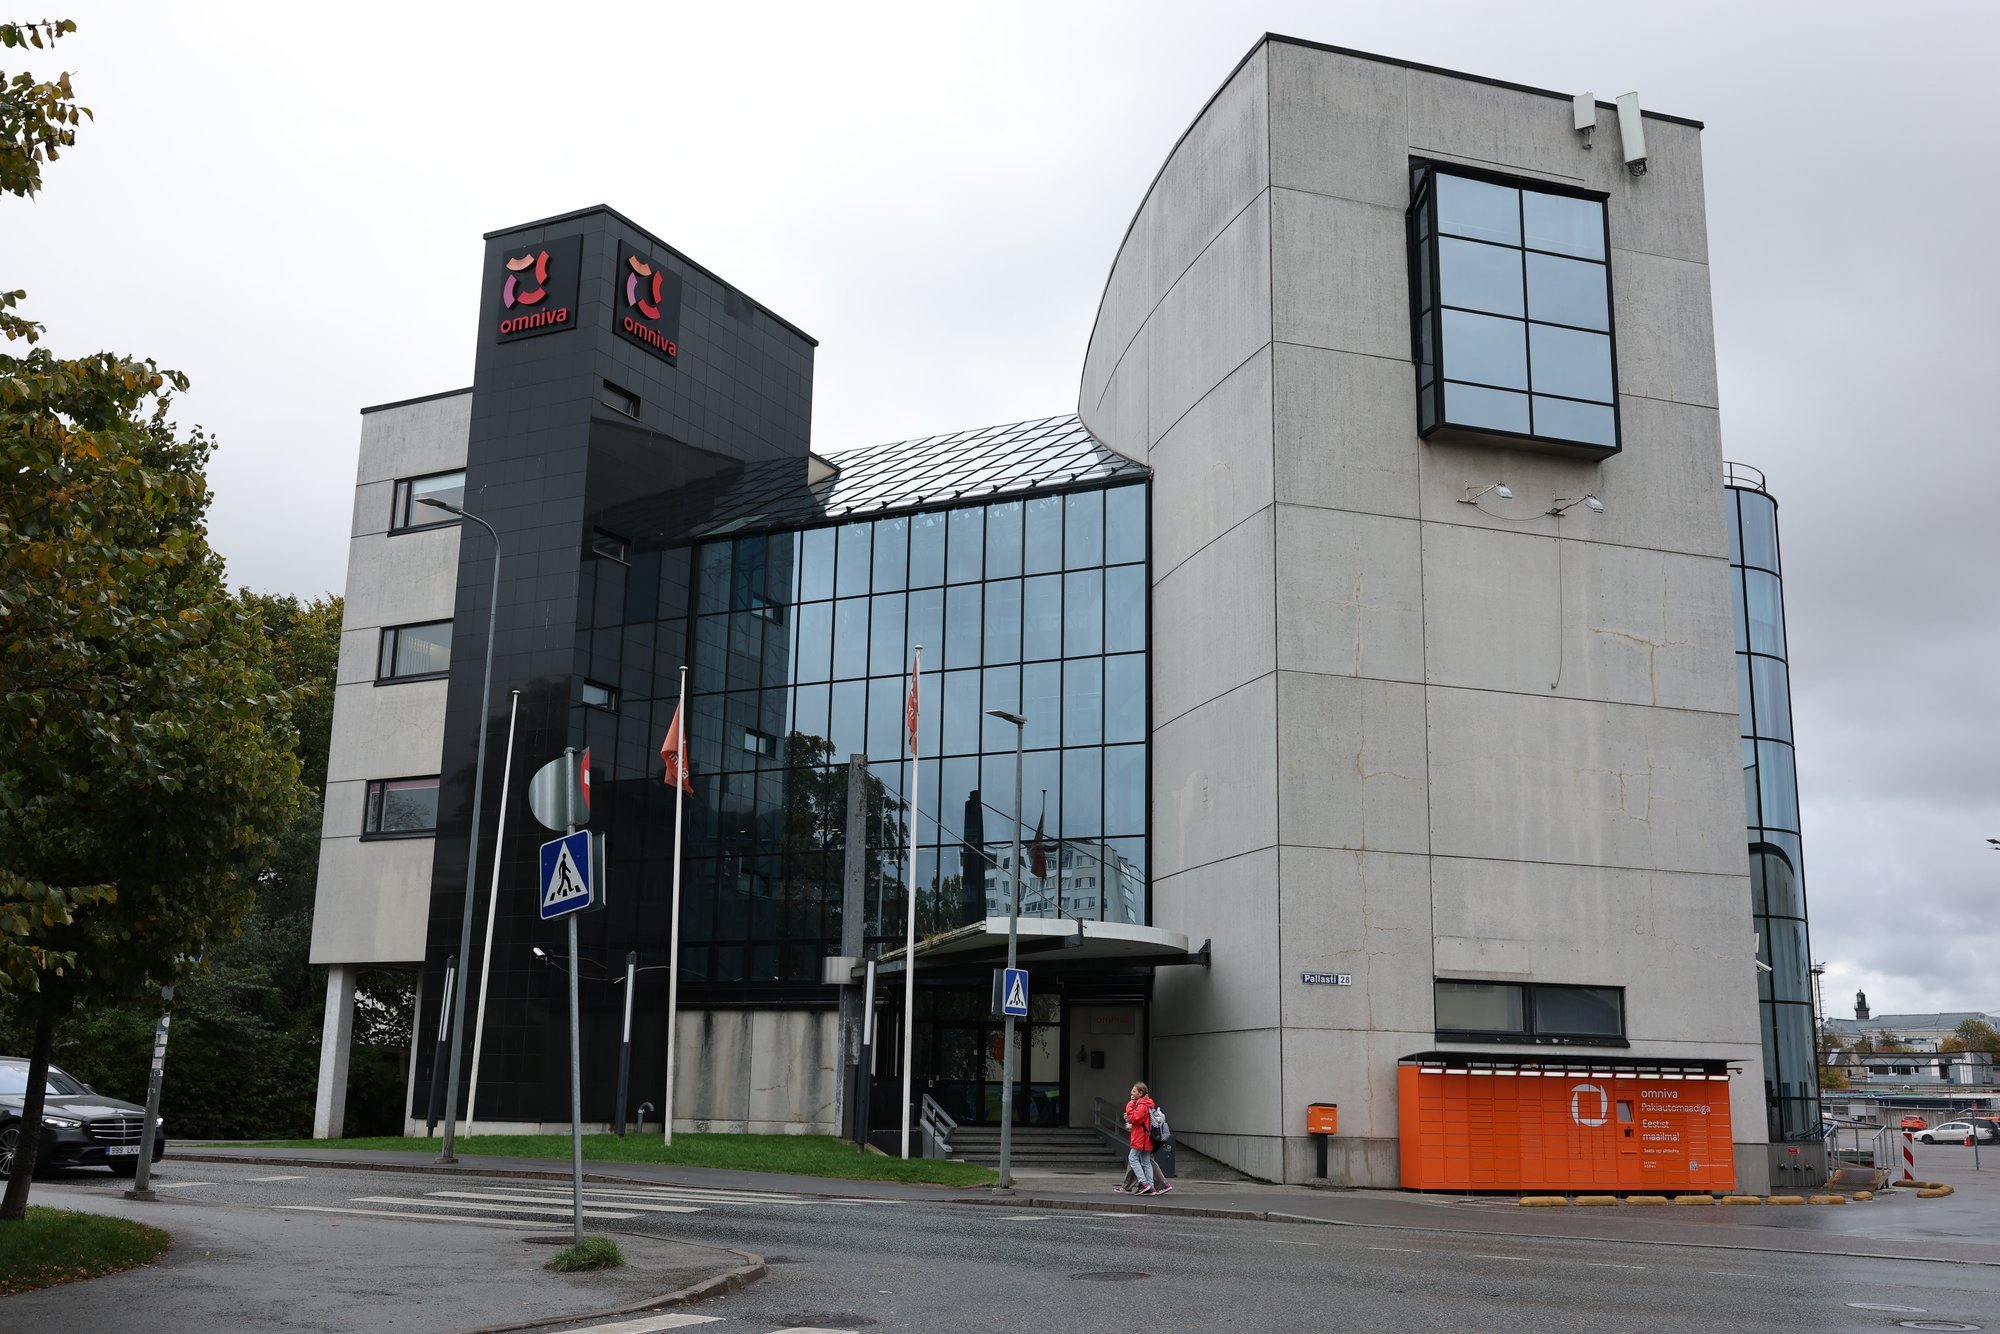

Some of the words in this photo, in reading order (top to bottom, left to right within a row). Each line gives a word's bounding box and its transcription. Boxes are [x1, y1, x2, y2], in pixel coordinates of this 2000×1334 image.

[500, 307, 567, 334] omniva
[624, 315, 677, 357] omniva
[1304, 974, 1337, 983] Pallasti
[1340, 976, 1350, 984] 28
[1641, 1088, 1678, 1099] omniva
[1641, 1102, 1711, 1115] Pakiautomaadiga
[1642, 1119, 1670, 1129] Eestist
